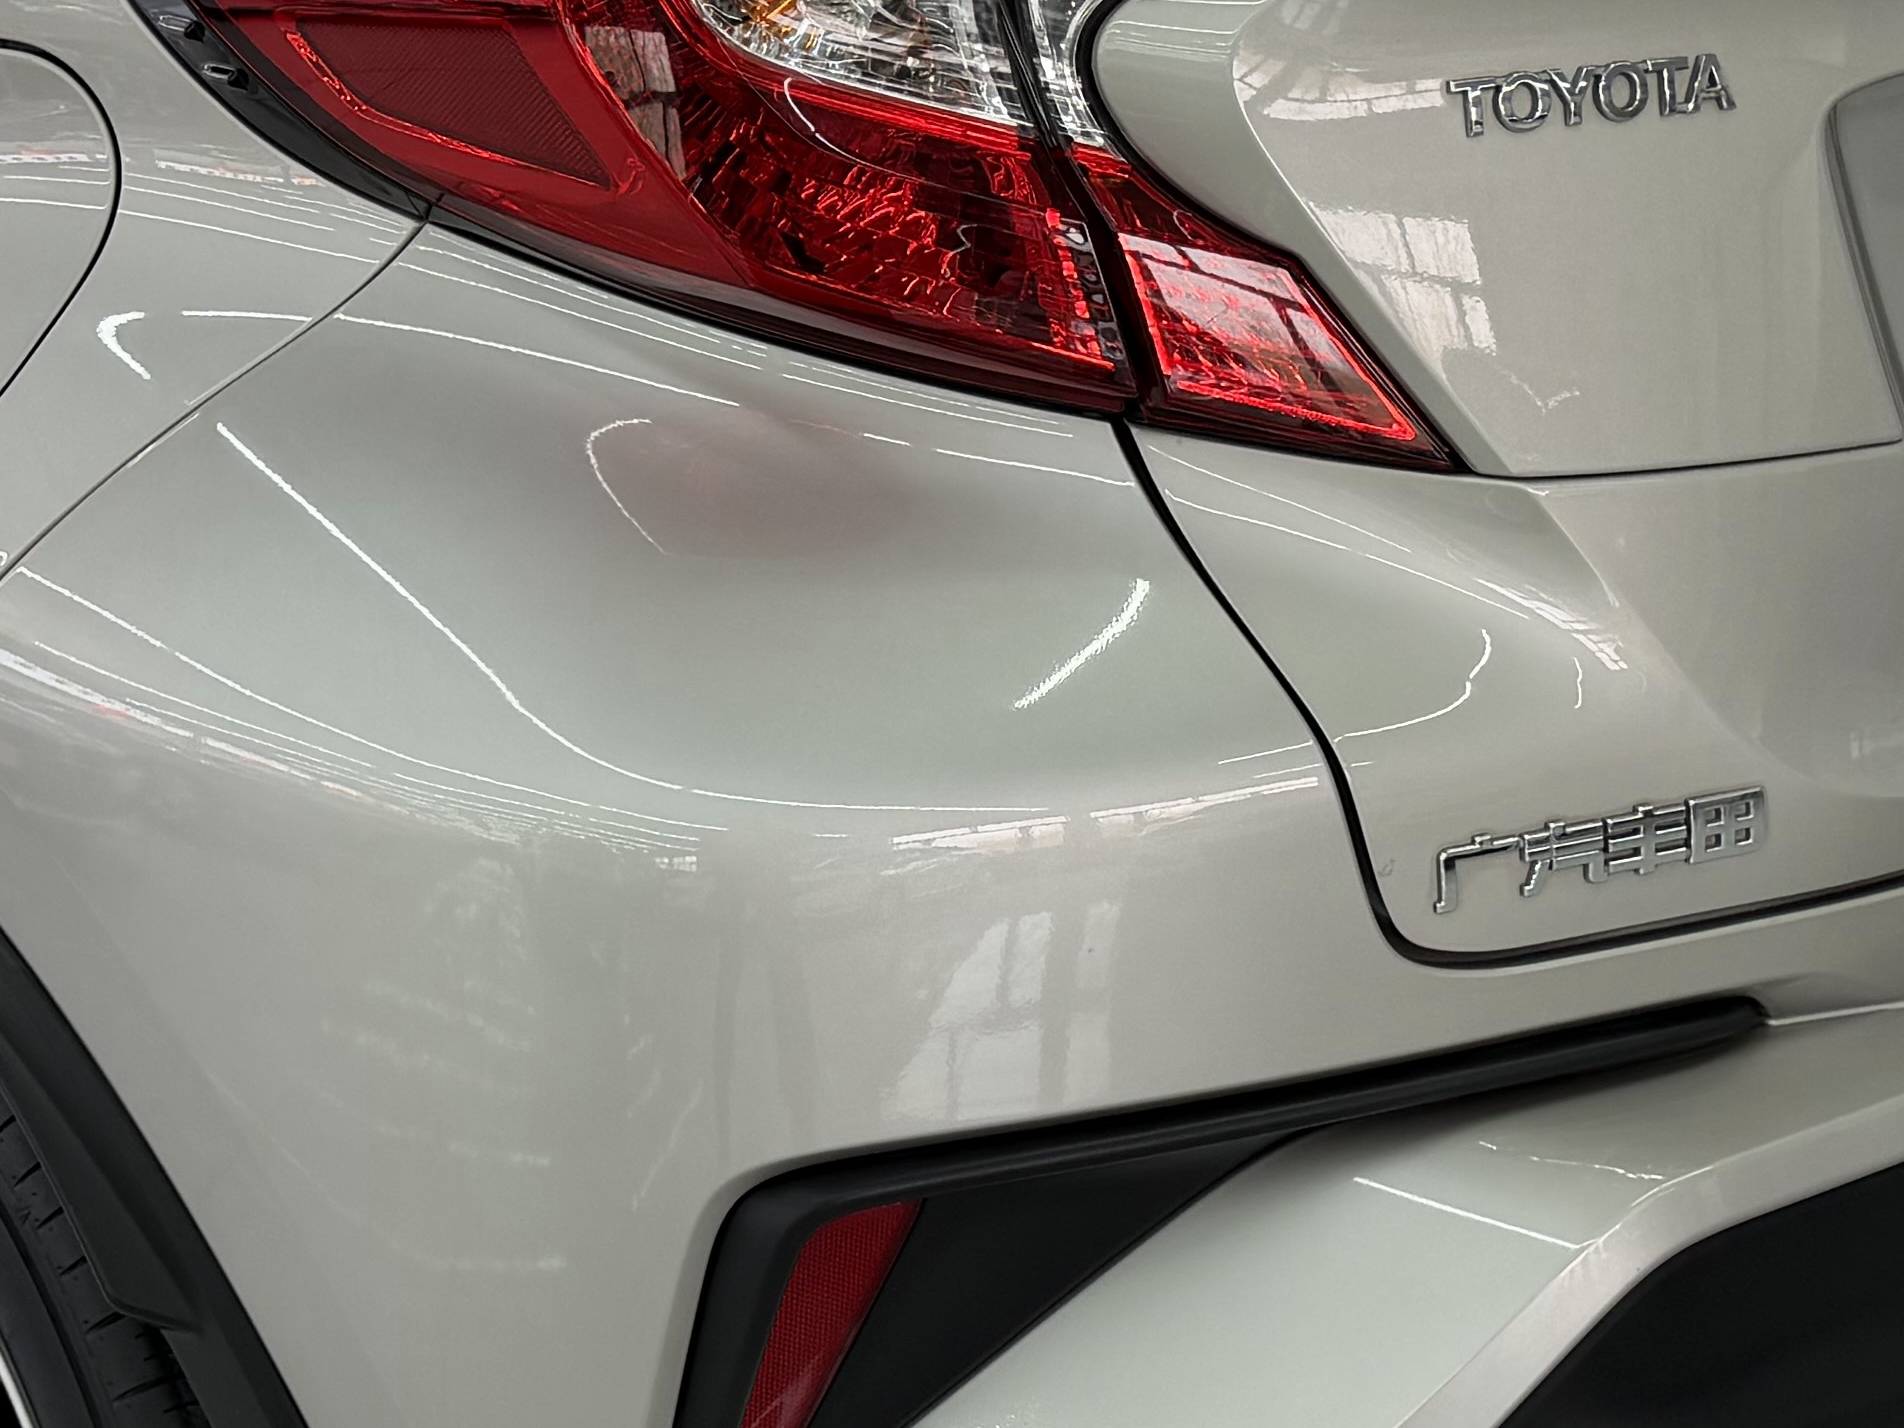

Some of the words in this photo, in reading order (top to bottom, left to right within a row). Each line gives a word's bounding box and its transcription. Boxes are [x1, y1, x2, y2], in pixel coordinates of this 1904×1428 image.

[1446, 52, 1738, 138] TOYOTA
[1432, 785, 1768, 914] 广汽丰田
